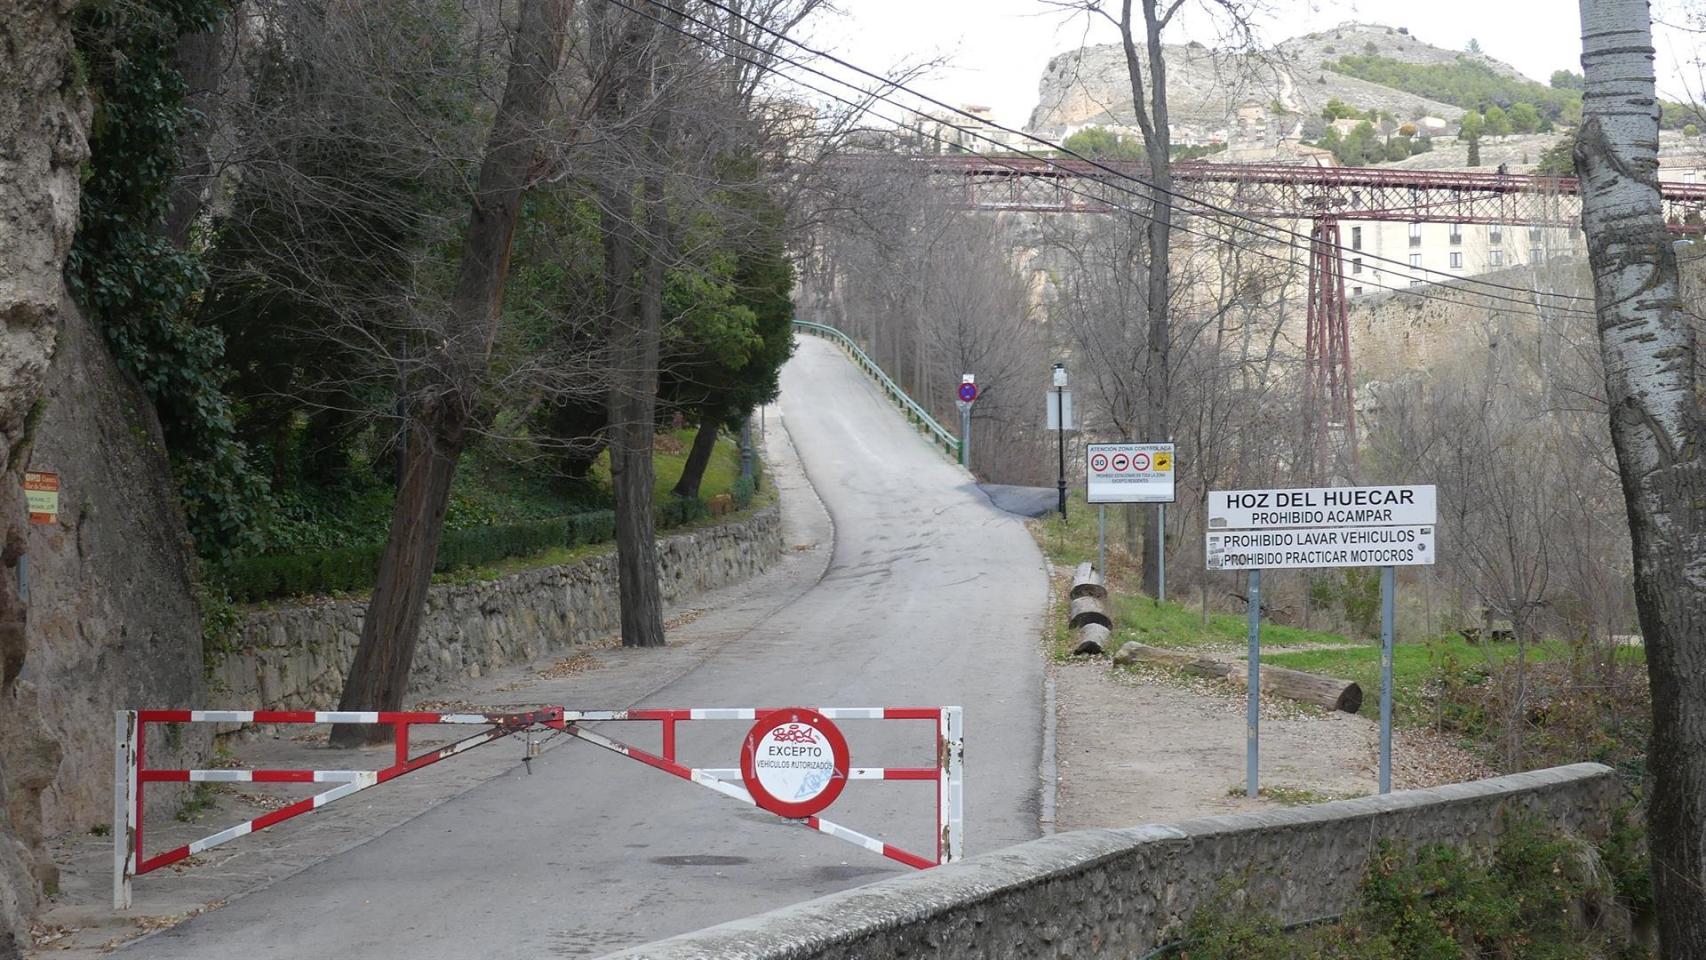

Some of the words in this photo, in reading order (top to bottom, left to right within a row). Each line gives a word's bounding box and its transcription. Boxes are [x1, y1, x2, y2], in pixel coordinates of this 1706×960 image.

[1227, 493, 1269, 509] HOZ
[1276, 492, 1317, 508] DEL
[1324, 489, 1414, 506] HUECAR
[1252, 510, 1324, 525] PROHIBIDO
[1327, 509, 1392, 523] ACAMPAR
[1223, 533, 1293, 548] PROHIBIDO
[1297, 532, 1338, 546] LAVAR
[1341, 529, 1415, 544] VEHICULOS
[1224, 552, 1283, 566] PROHIBIDO
[1286, 550, 1347, 564] PRACTICAR
[1350, 548, 1414, 563] MOTOCROS
[768, 746, 822, 757] EXCEPTO
[791, 761, 833, 770] AUTORIZADOS
